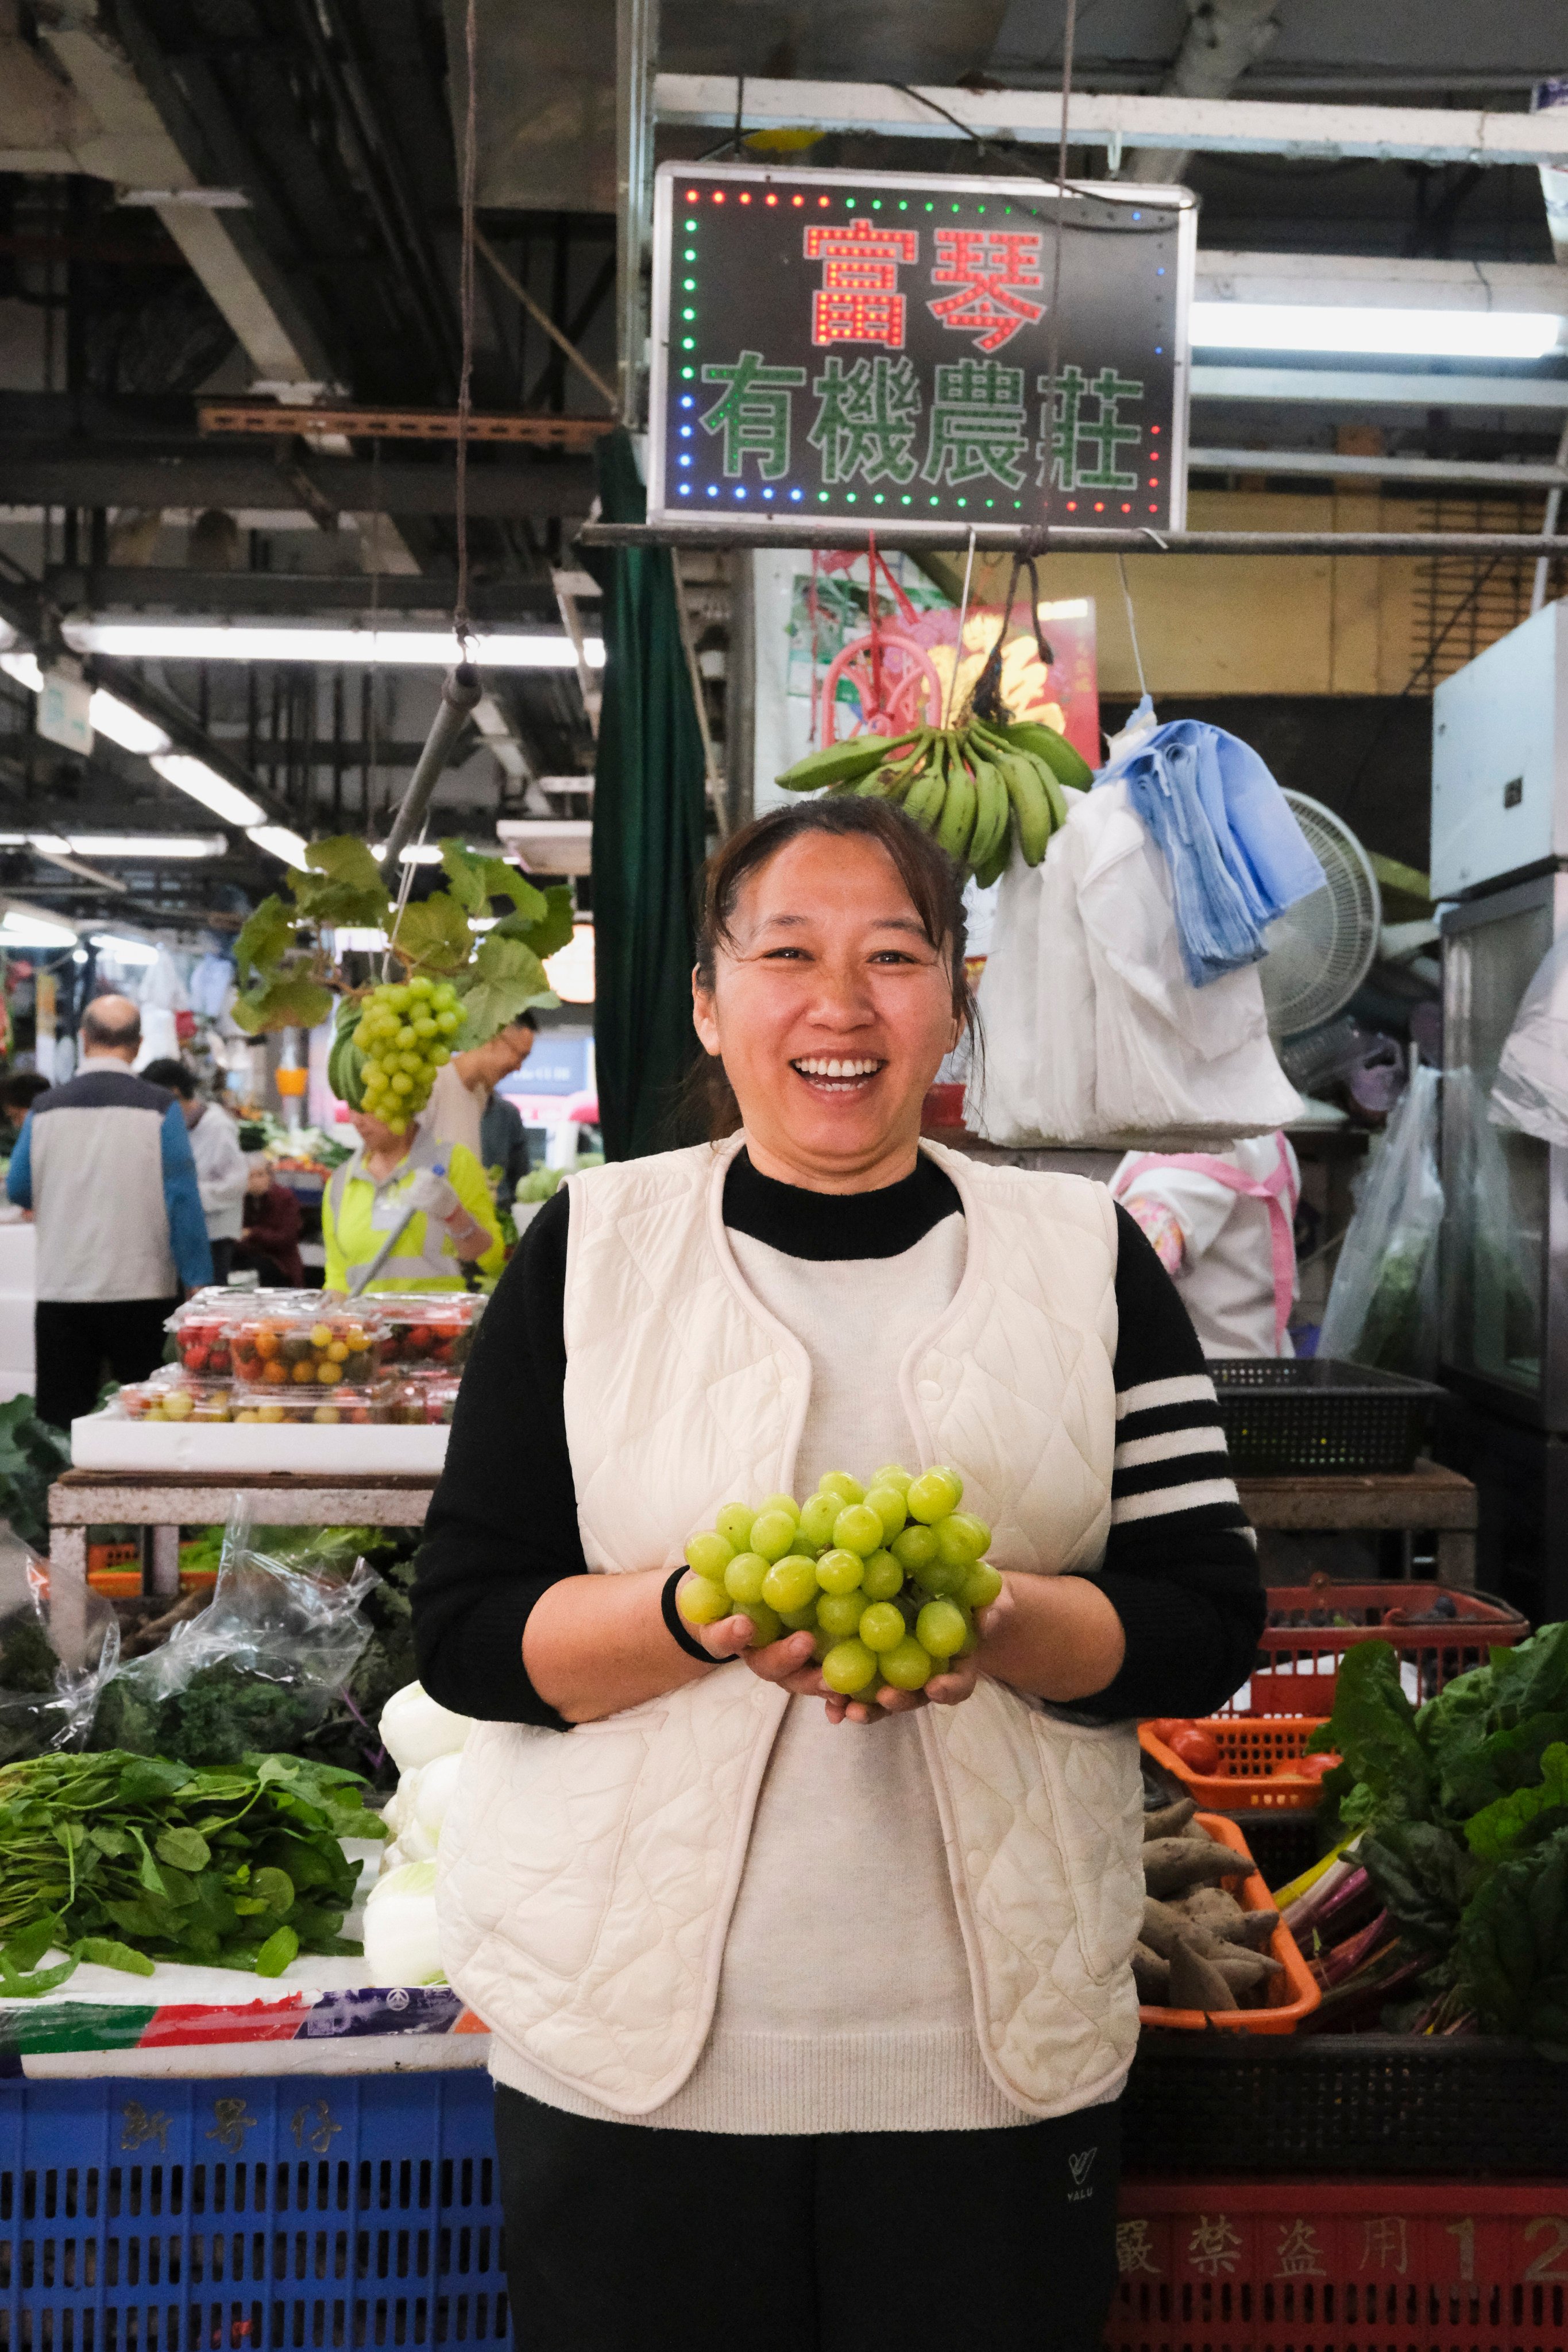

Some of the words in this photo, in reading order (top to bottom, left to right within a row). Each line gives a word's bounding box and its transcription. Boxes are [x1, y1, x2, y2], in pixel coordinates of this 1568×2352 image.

[804, 218, 1046, 353] 富琴
[699, 350, 1144, 491] 有機農莊
